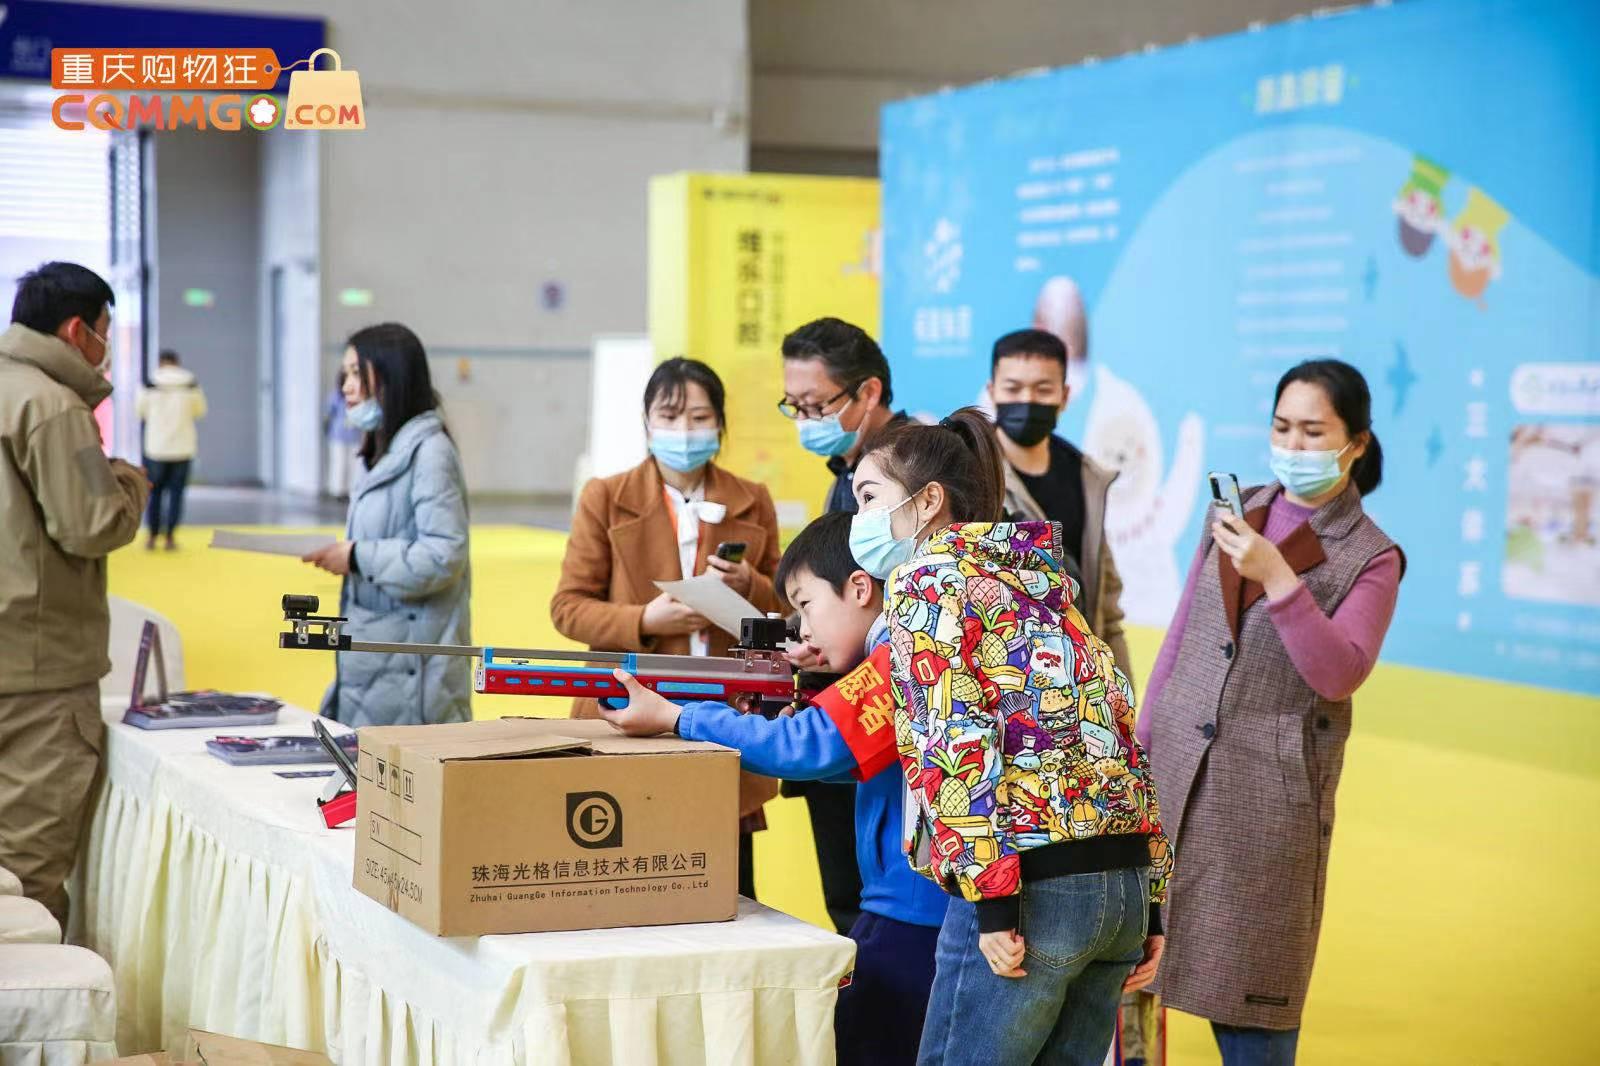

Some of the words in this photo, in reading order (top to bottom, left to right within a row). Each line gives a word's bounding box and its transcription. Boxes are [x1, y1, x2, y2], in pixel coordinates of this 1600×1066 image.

[472, 852, 706, 882] 珠海光格信息技术有限公司
[470, 893, 503, 903] Zhuhai
[507, 890, 546, 901] GuangGe
[551, 887, 610, 899] Information
[614, 884, 668, 895] Technology
